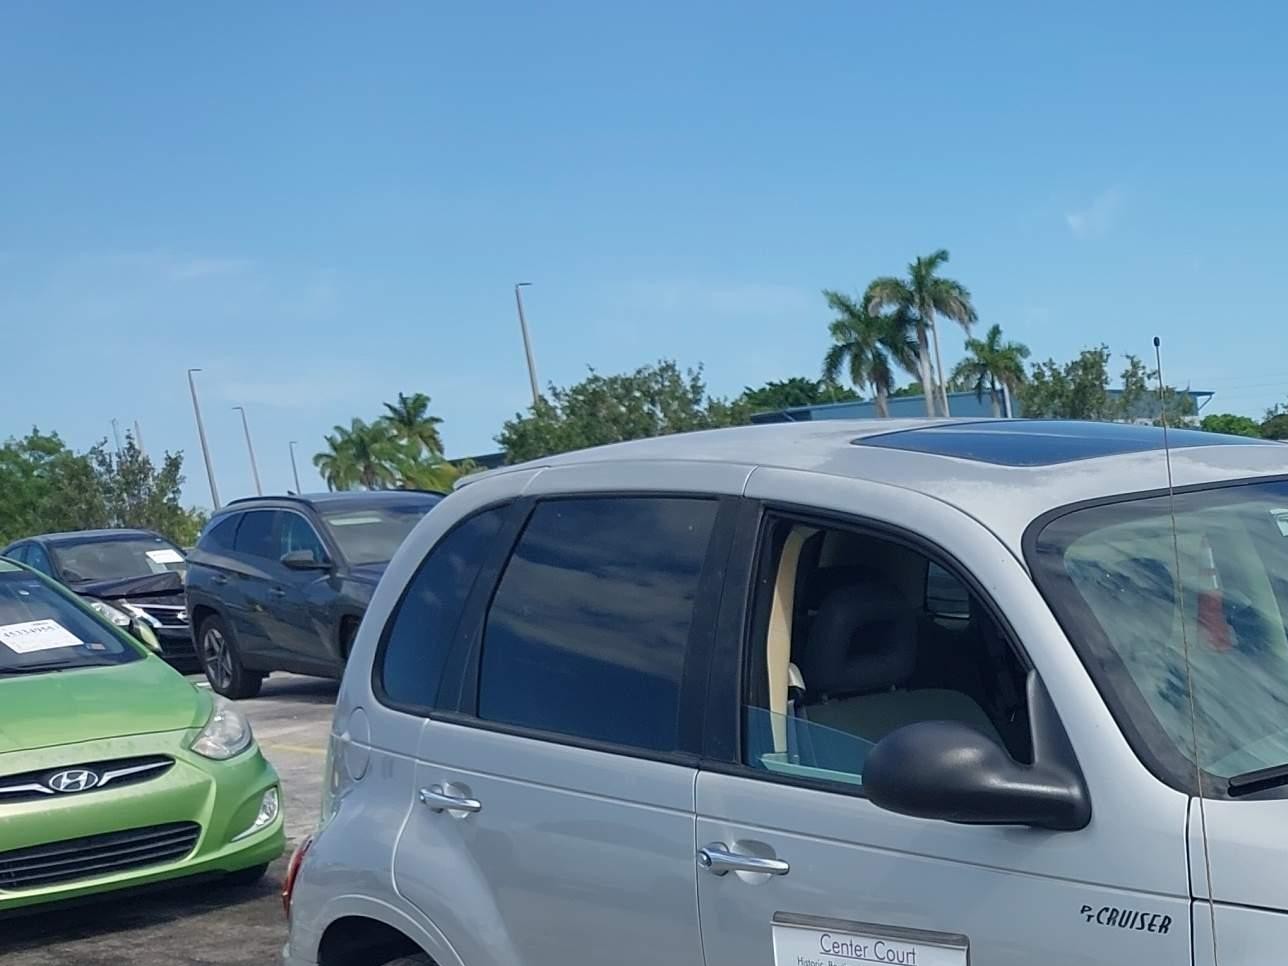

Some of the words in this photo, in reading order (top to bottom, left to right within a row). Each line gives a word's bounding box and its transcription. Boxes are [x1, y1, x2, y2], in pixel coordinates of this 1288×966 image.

[1096, 906, 1173, 934] CRUISER
[820, 933, 868, 958] Center
[873, 940, 917, 965] Court
